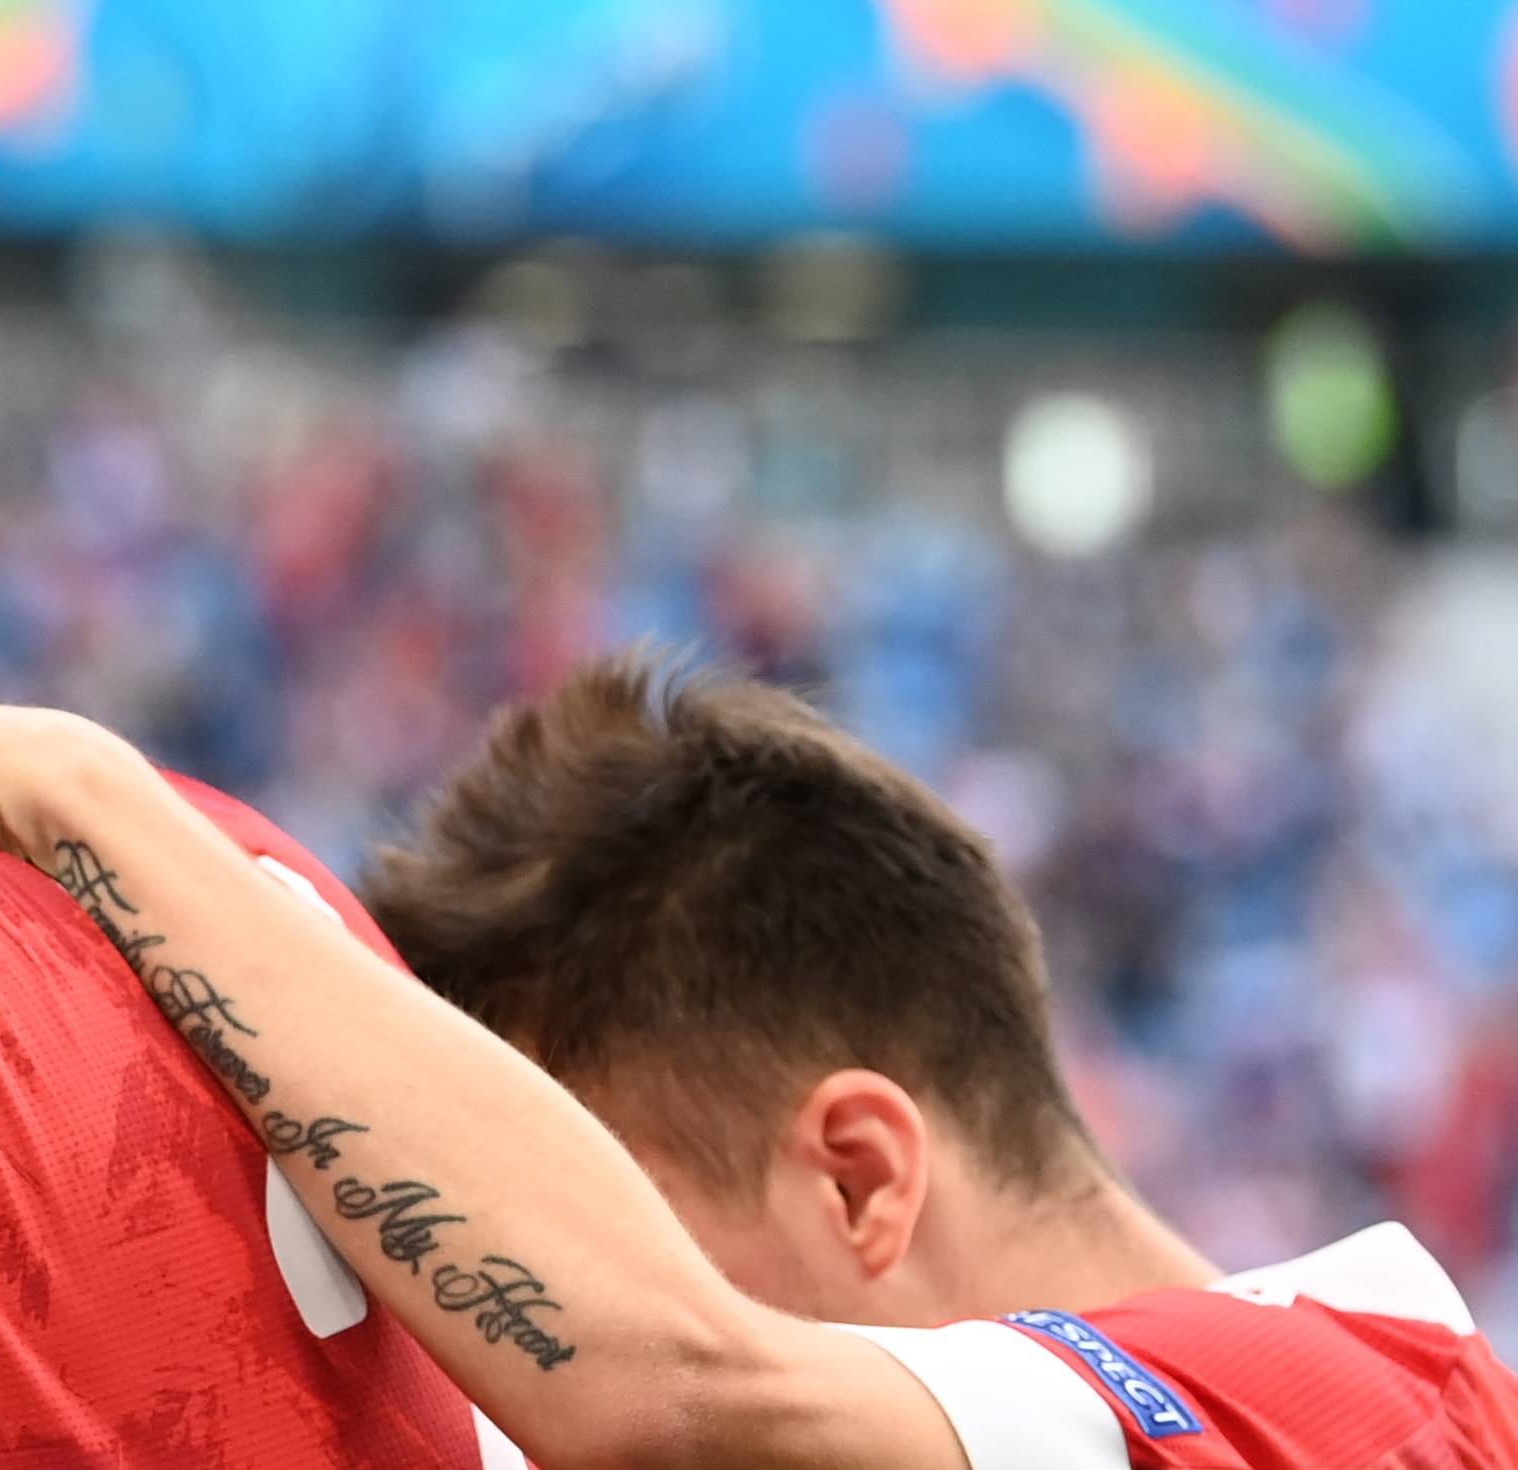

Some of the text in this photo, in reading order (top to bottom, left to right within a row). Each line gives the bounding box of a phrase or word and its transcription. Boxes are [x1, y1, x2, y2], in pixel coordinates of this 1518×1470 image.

[262, 1111, 369, 1170] In
[333, 1177, 467, 1277] My
[432, 1256, 577, 1371] Heart
